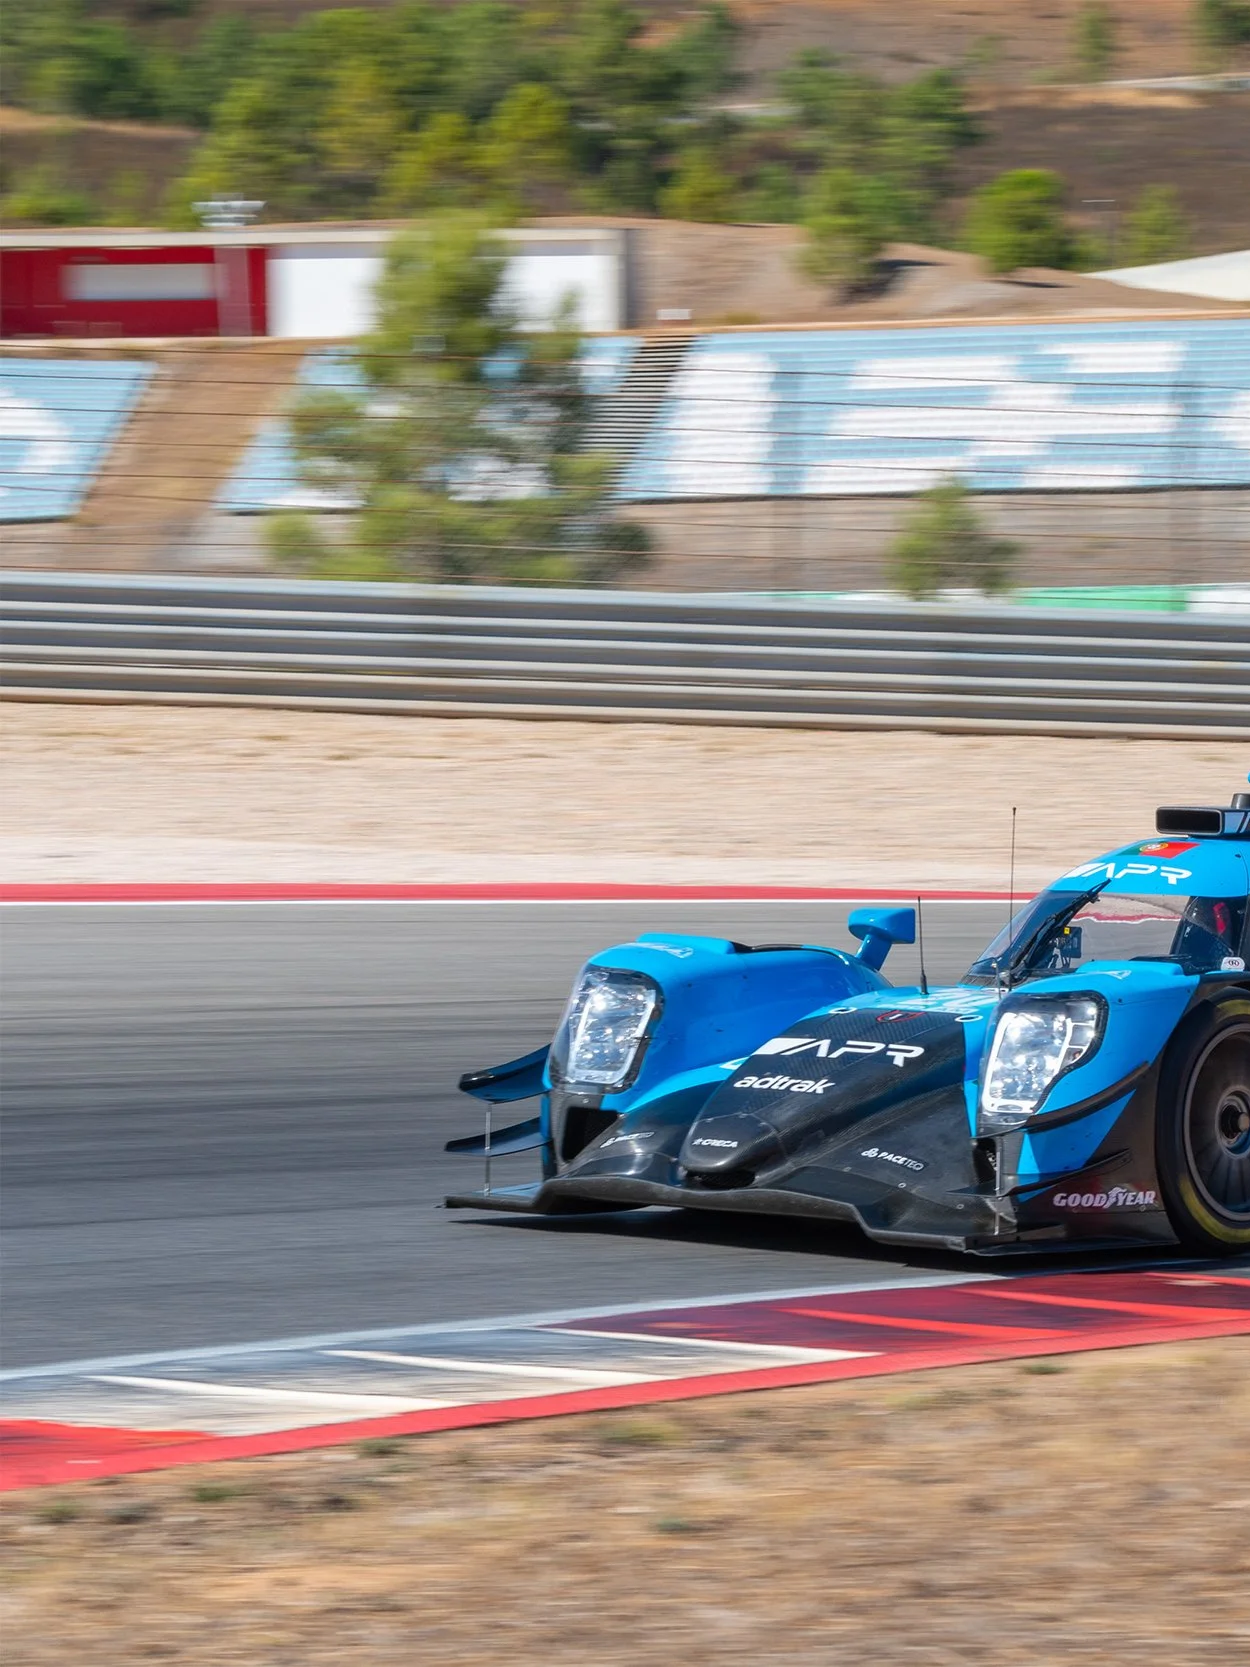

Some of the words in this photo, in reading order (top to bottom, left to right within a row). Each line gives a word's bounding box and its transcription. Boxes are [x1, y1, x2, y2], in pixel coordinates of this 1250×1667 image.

[1080, 863, 1192, 885] APR
[780, 1038, 925, 1068] APR
[733, 1074, 836, 1094] adtrak
[1053, 1187, 1156, 1209] GOODYEAR
